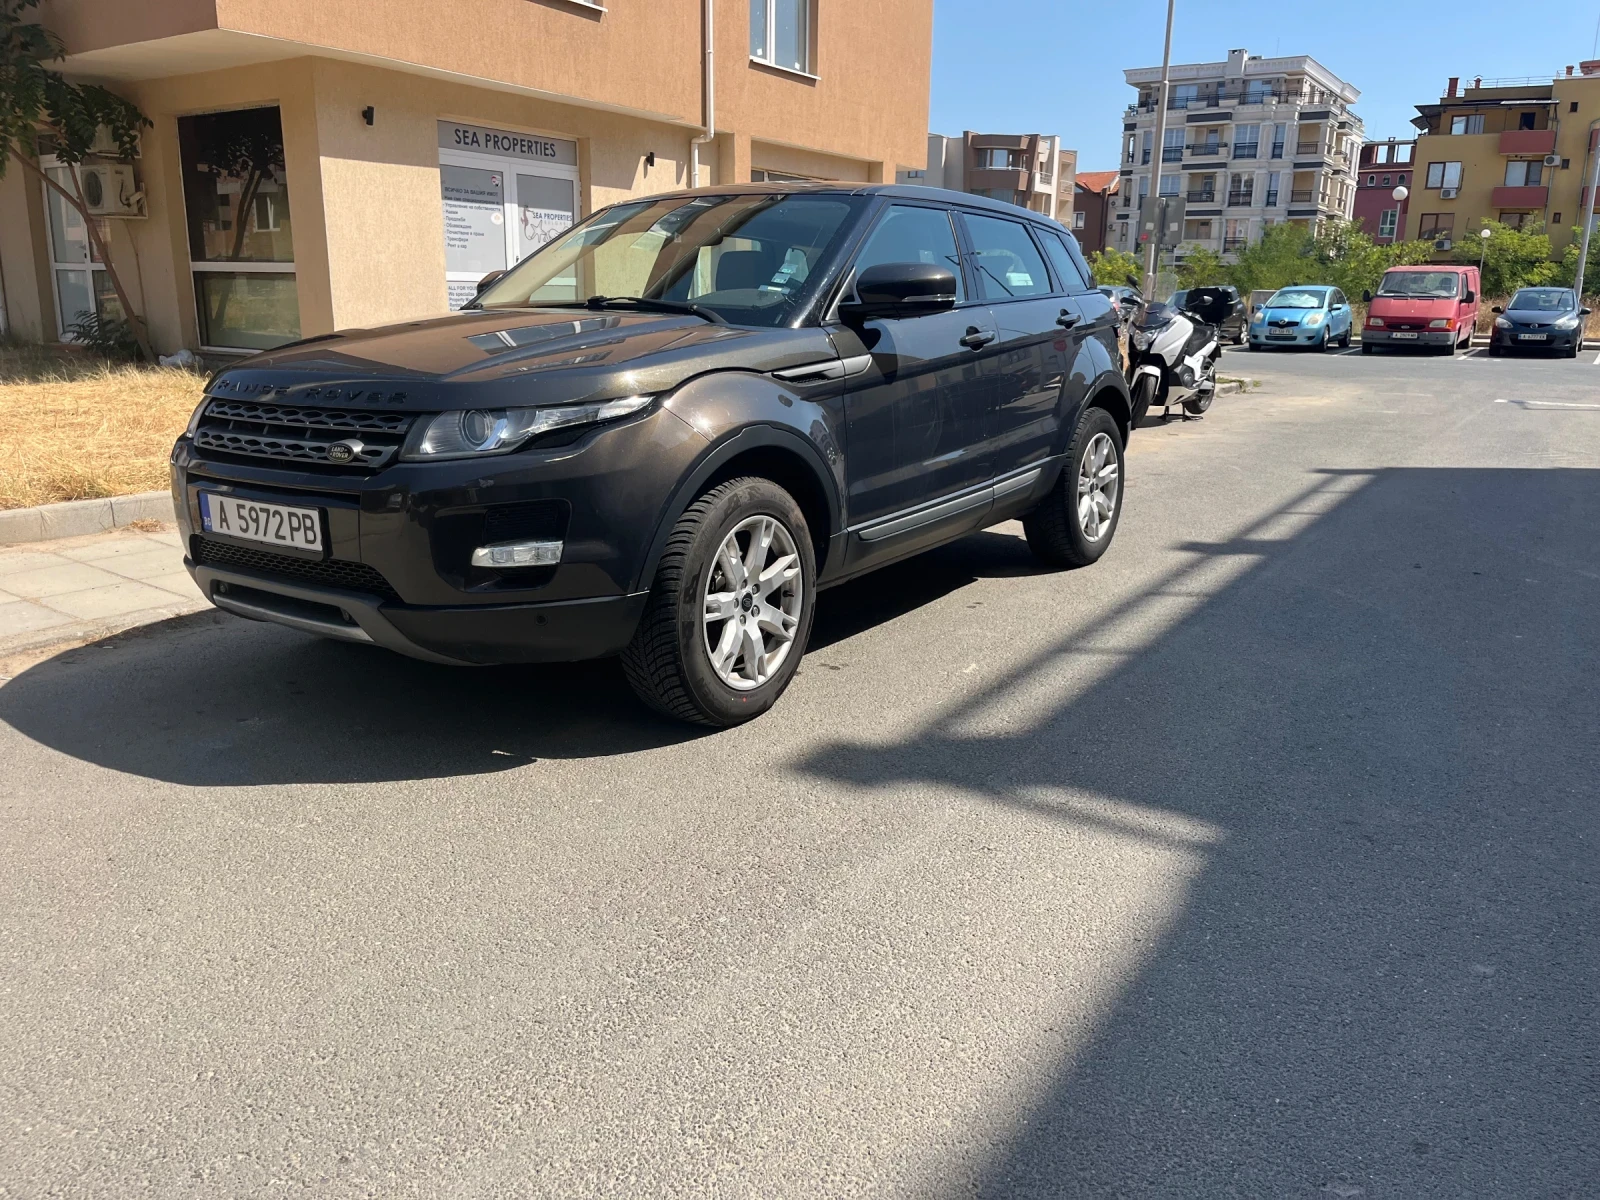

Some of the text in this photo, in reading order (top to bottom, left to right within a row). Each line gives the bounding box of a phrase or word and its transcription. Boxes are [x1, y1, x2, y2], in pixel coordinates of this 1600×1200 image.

[454, 128, 556, 157] SEA PROPERTIES
[543, 213, 572, 221] PROPERTIES
[218, 379, 408, 404] RANGE ROVER
[203, 516, 212, 526] BG
[219, 500, 231, 531] A
